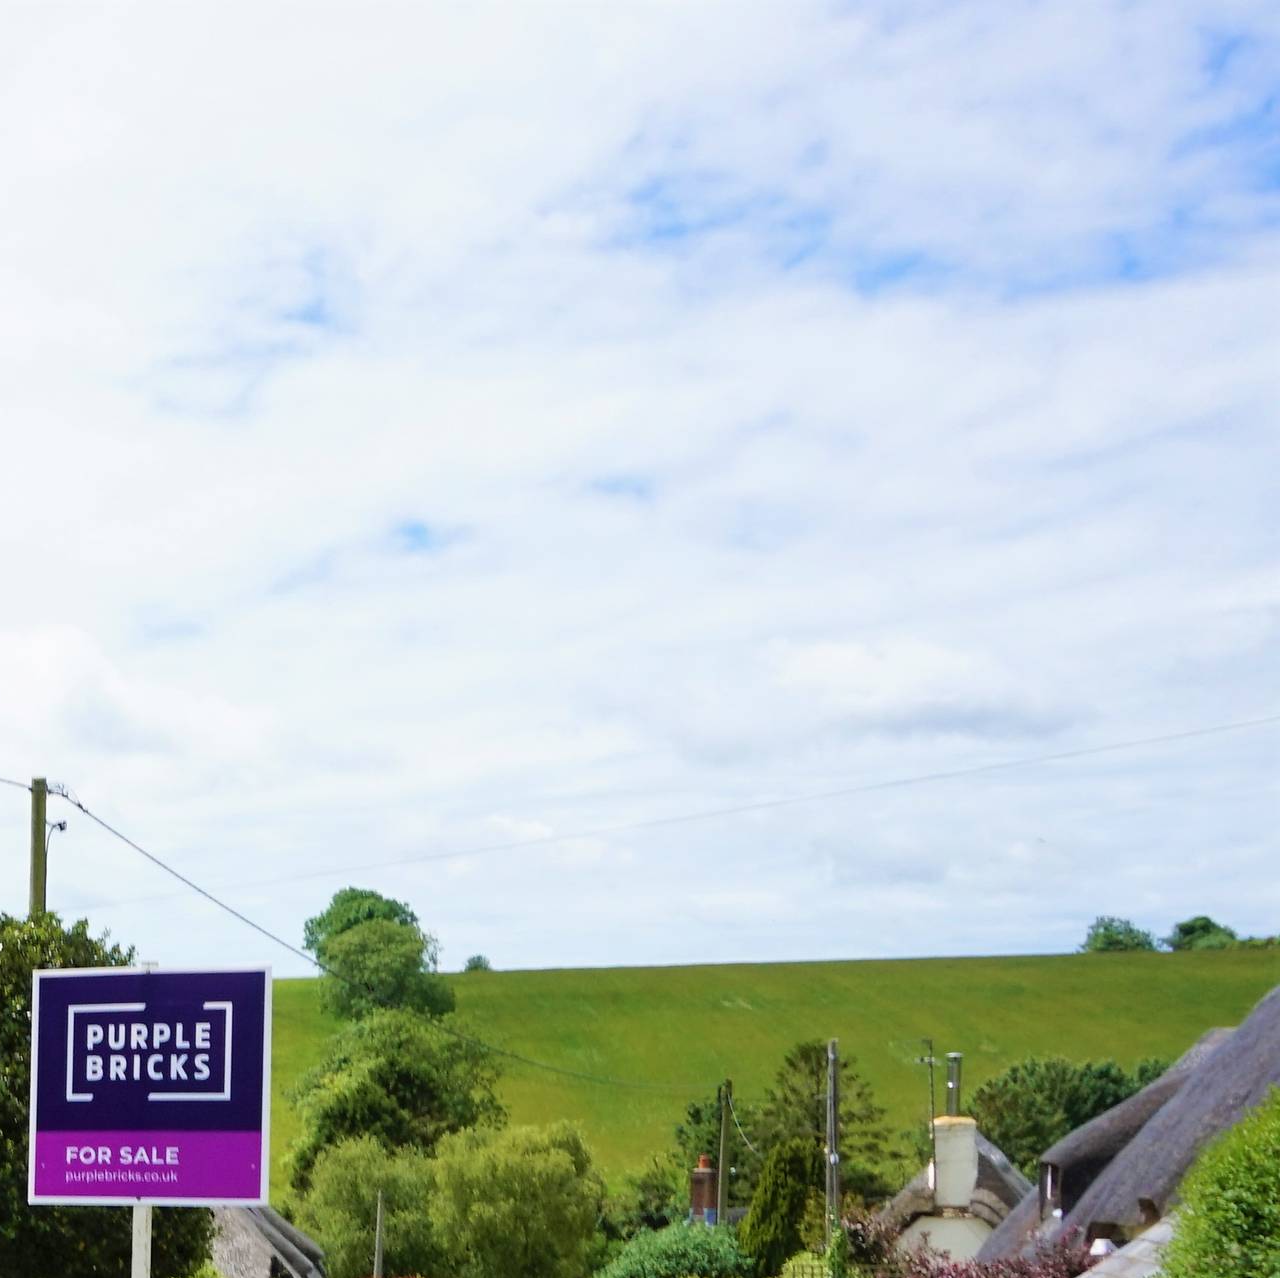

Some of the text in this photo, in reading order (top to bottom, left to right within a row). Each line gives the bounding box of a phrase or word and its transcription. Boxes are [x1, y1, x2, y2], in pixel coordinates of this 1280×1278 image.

[86, 1022, 211, 1050] PURPLE
[86, 1054, 211, 1081] BRICKS
[65, 1146, 179, 1165] FOR SALE
[65, 1169, 178, 1183] purplebricks.co.uk
